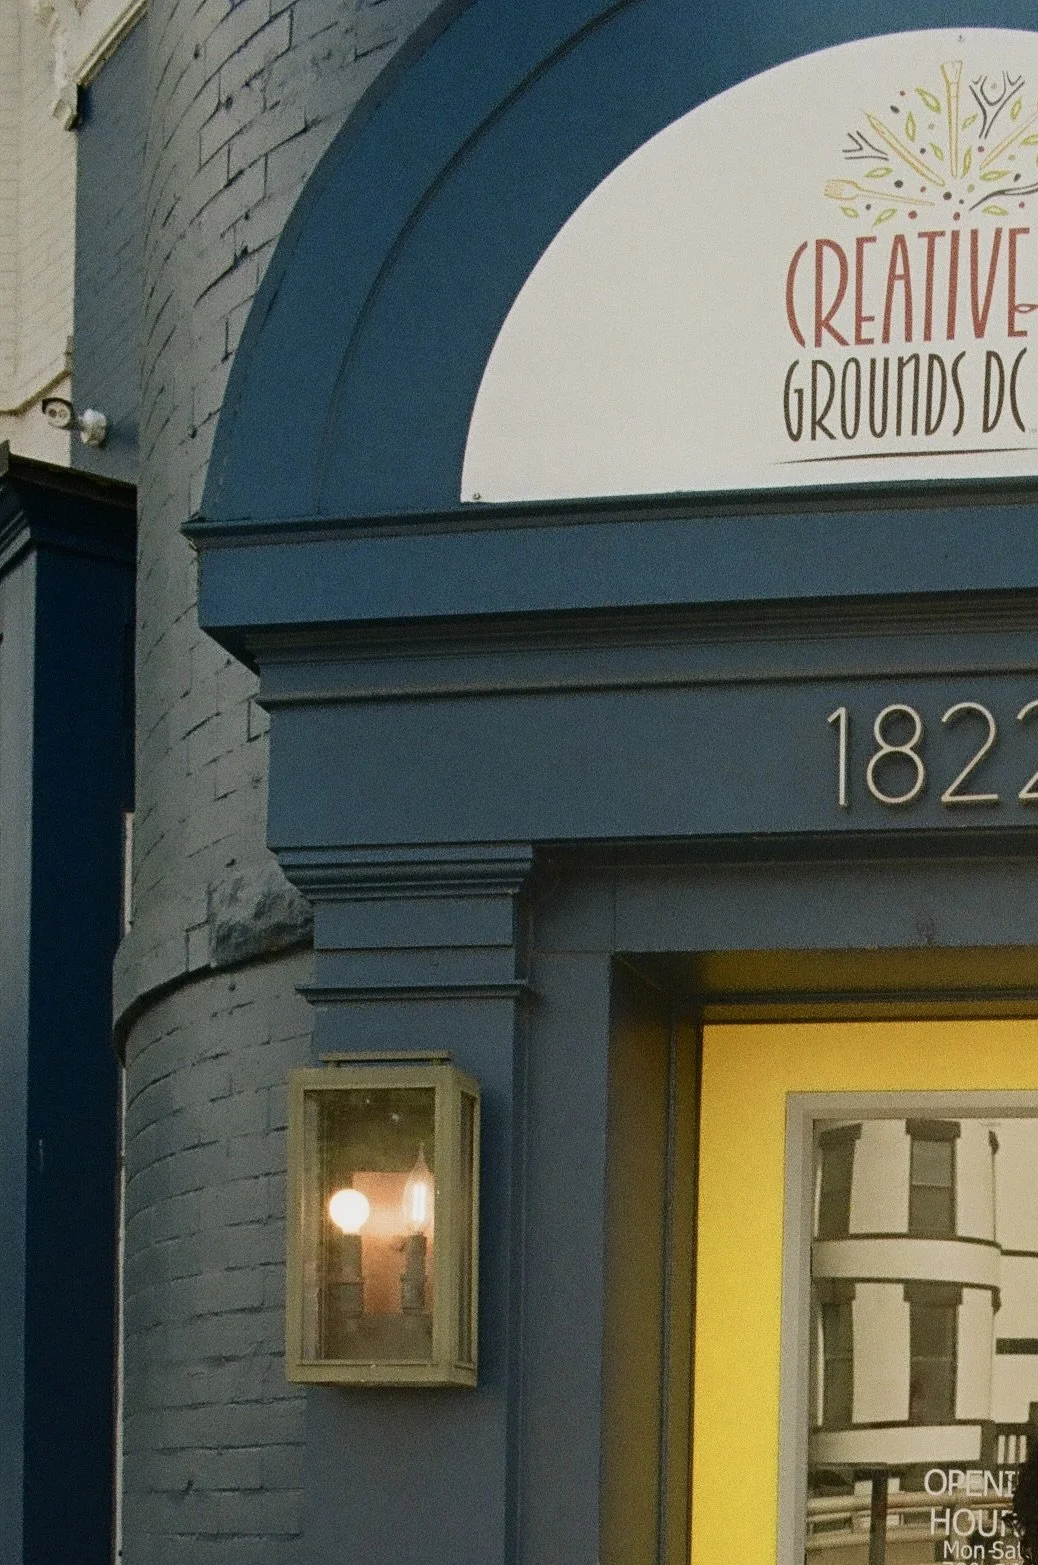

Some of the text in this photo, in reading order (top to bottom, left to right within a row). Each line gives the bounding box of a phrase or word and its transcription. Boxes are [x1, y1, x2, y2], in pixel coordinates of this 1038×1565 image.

[783, 347, 1028, 443] GROUNDS DC
[924, 1468, 1019, 1498] OPENI
[930, 1507, 1024, 1537] HOUR
